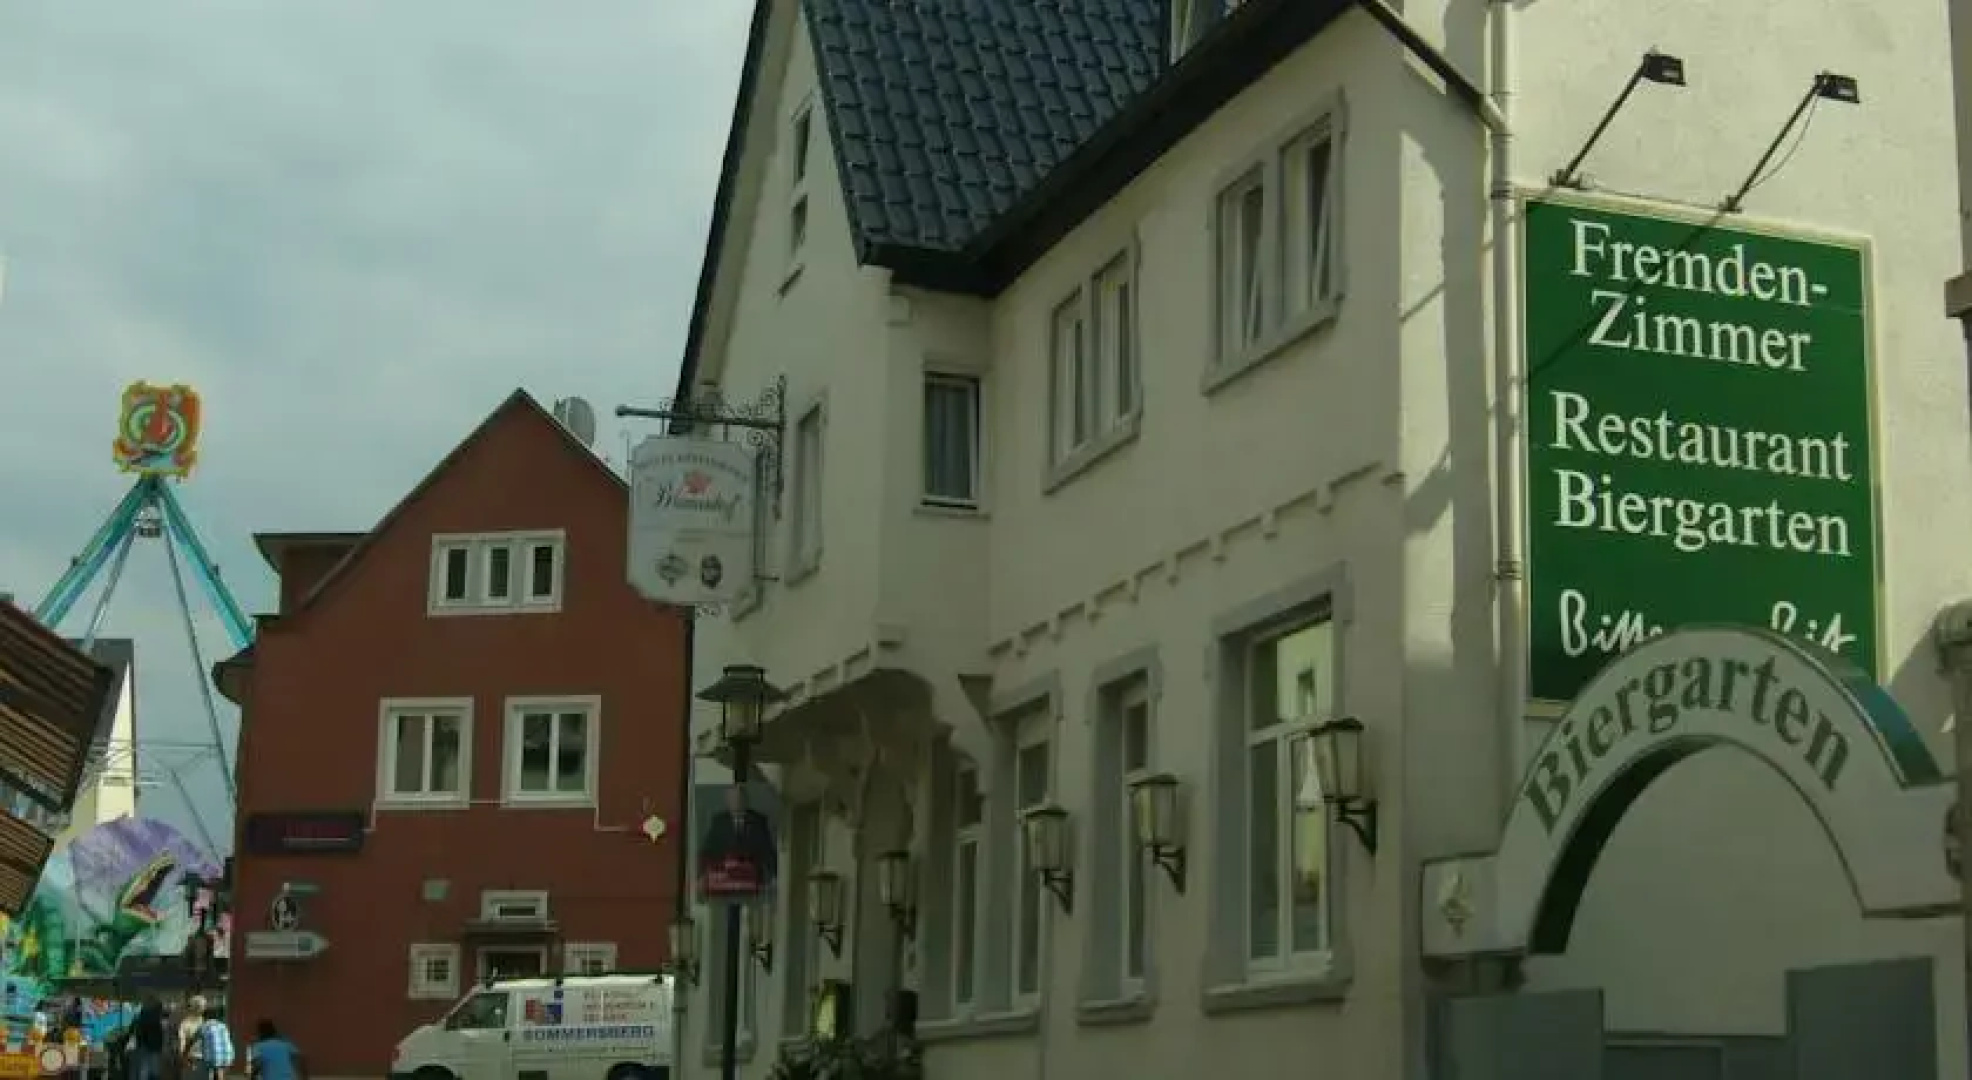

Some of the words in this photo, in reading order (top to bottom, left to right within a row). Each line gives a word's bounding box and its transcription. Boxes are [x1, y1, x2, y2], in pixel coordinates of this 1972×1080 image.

[1569, 219, 1829, 307] Fremden-
[1587, 289, 1812, 372] Zimmer
[1550, 390, 1854, 482] Restaurant
[1554, 468, 1852, 557] Biergarten
[1524, 655, 1849, 836] Biergarten
